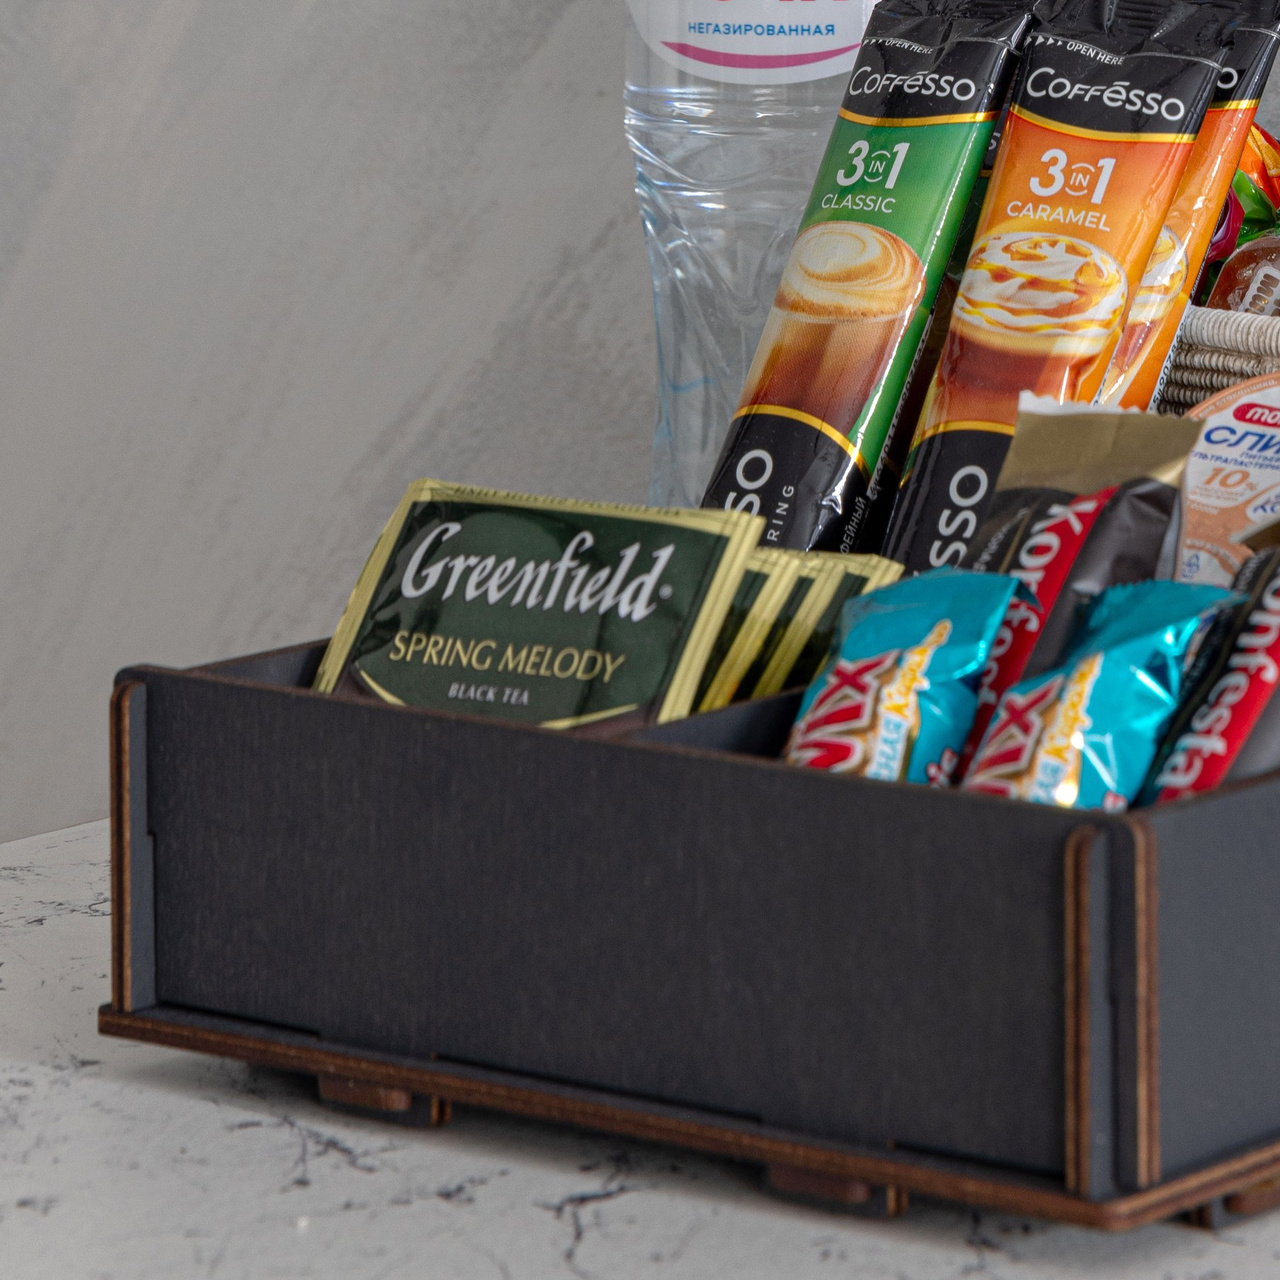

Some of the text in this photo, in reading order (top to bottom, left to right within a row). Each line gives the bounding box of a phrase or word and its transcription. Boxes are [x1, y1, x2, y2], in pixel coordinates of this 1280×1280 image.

[687, 21, 836, 37] НЕГАЗИРОВАННАЯ
[910, 42, 934, 55] HERE
[1066, 41, 1124, 66] OPEN HERE
[820, 194, 897, 214] CLASSIC
[1007, 199, 1112, 233] CARAMEL
[840, 496, 867, 555] ФЕЙНЫЙ
[400, 522, 677, 621] Greenfield
[388, 630, 626, 685] SPRING MELODY
[447, 681, 530, 706] BLACK TEA
